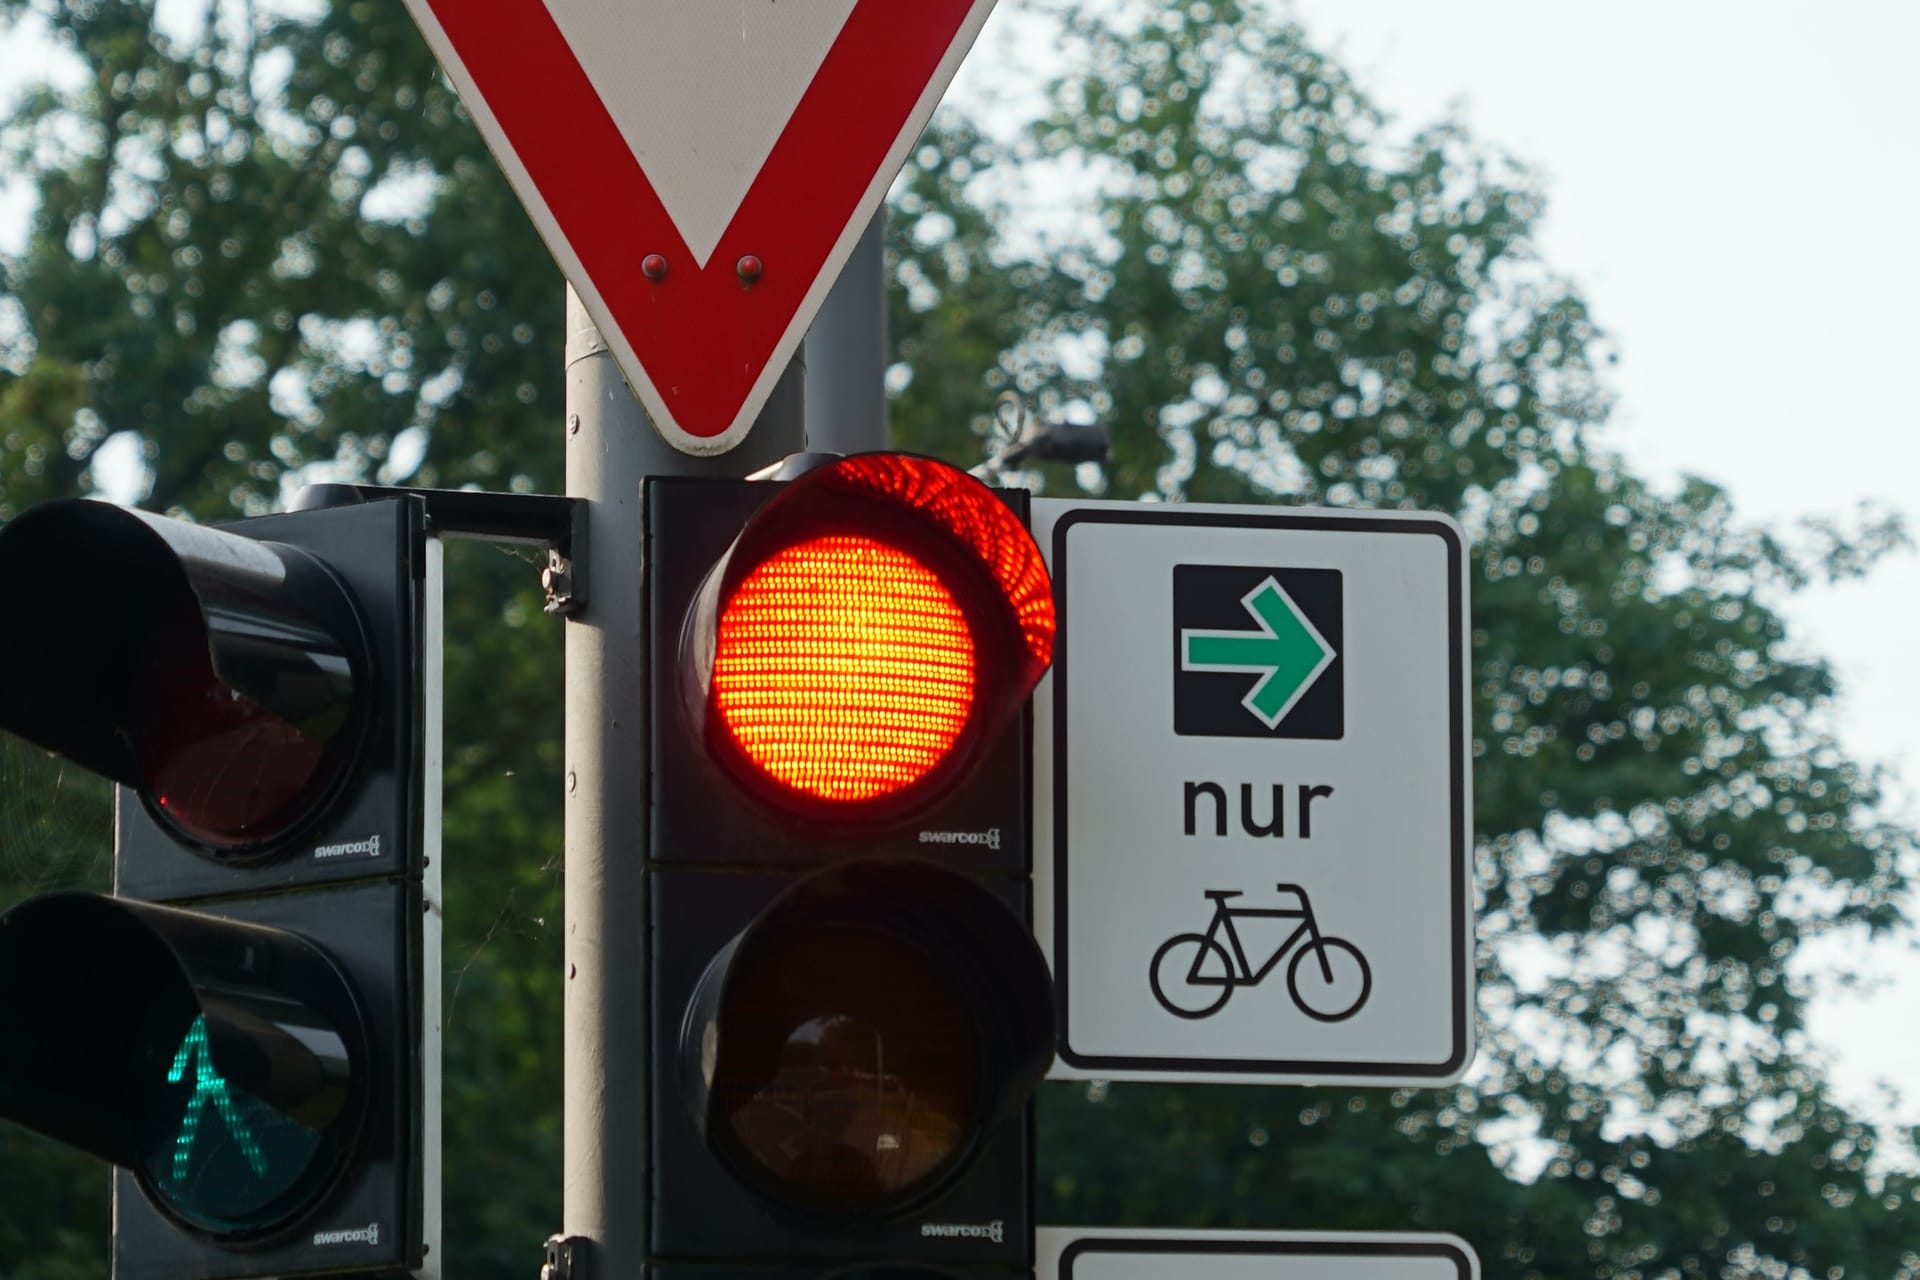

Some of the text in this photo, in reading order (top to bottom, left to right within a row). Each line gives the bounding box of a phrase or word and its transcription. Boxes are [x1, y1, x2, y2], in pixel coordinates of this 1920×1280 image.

[1184, 781, 1334, 838] nur
[919, 831, 979, 844] swarco
[315, 841, 362, 858] swarco
[313, 1230, 361, 1245] swarco
[921, 1224, 981, 1237] swarco
